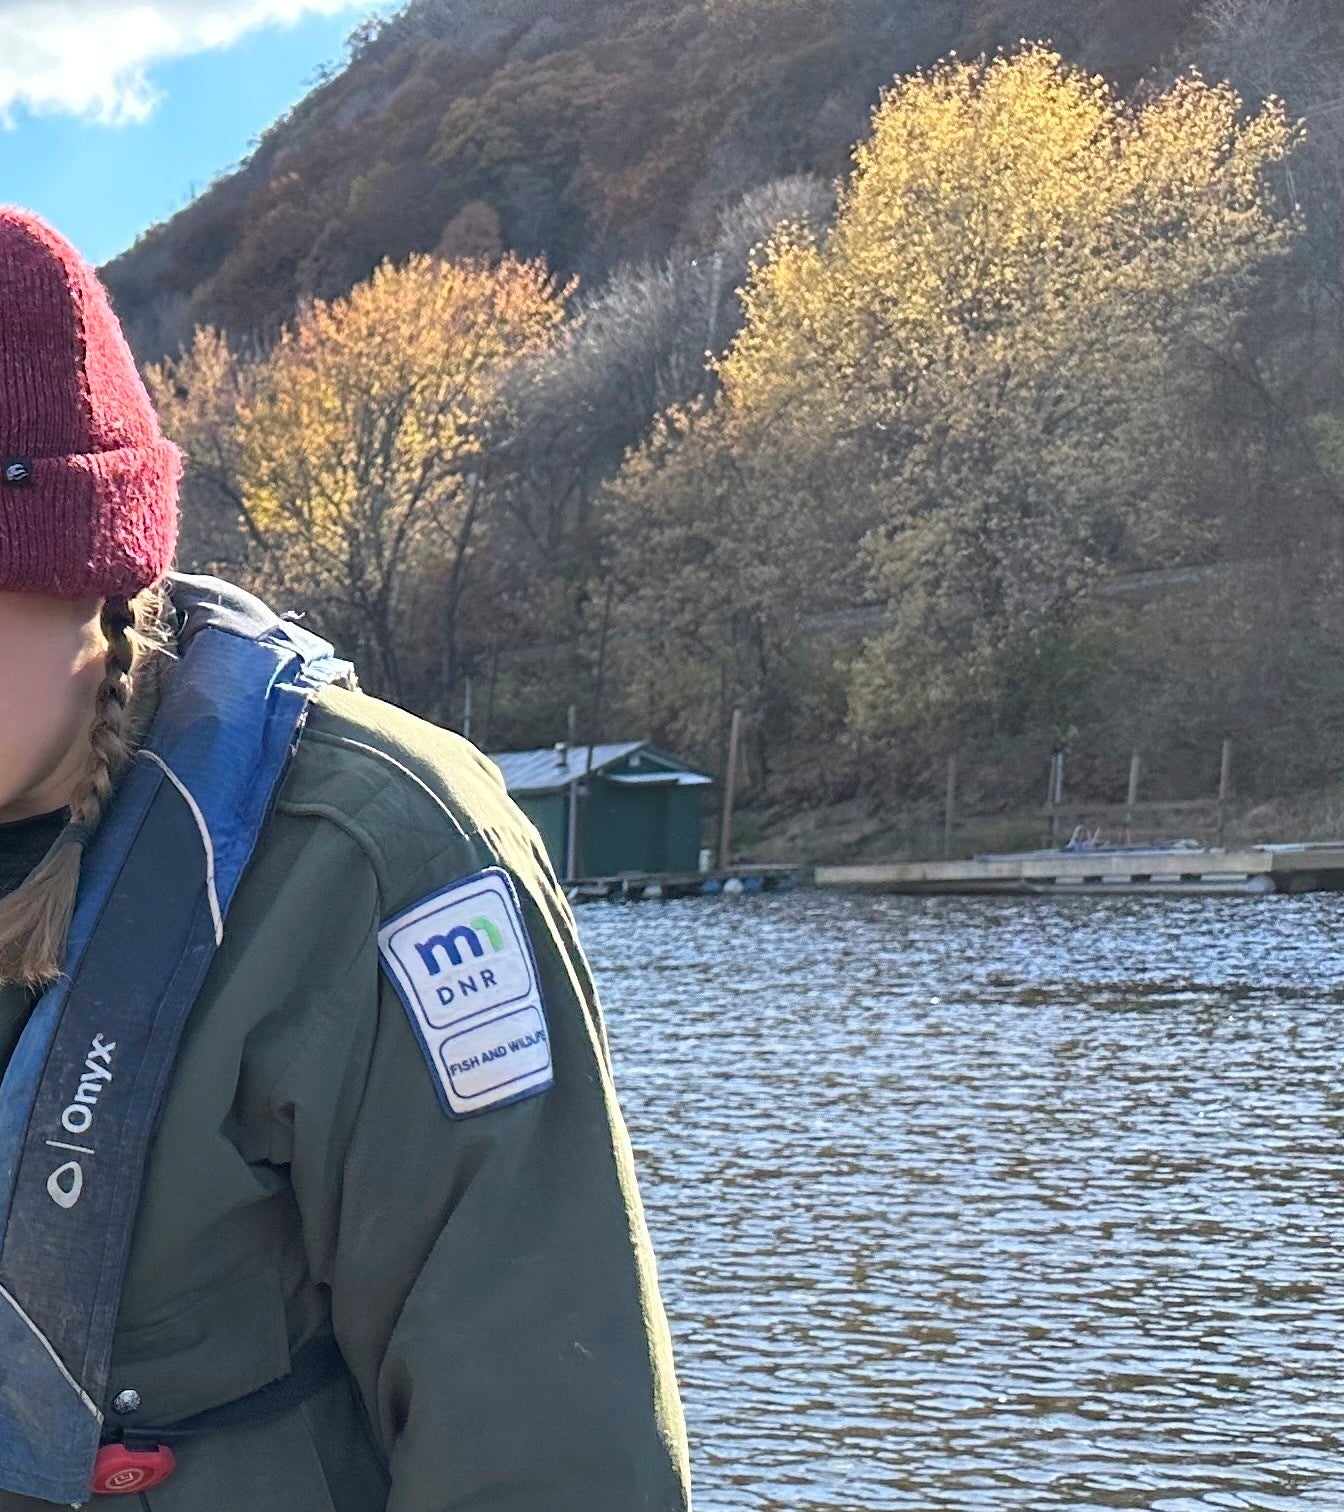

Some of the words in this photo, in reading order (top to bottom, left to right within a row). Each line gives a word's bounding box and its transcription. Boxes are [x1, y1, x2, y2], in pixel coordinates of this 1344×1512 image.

[436, 968, 497, 1006] DNR
[449, 1055, 480, 1076] FISH
[482, 1045, 507, 1064] AND
[61, 1033, 116, 1134] Onyx
